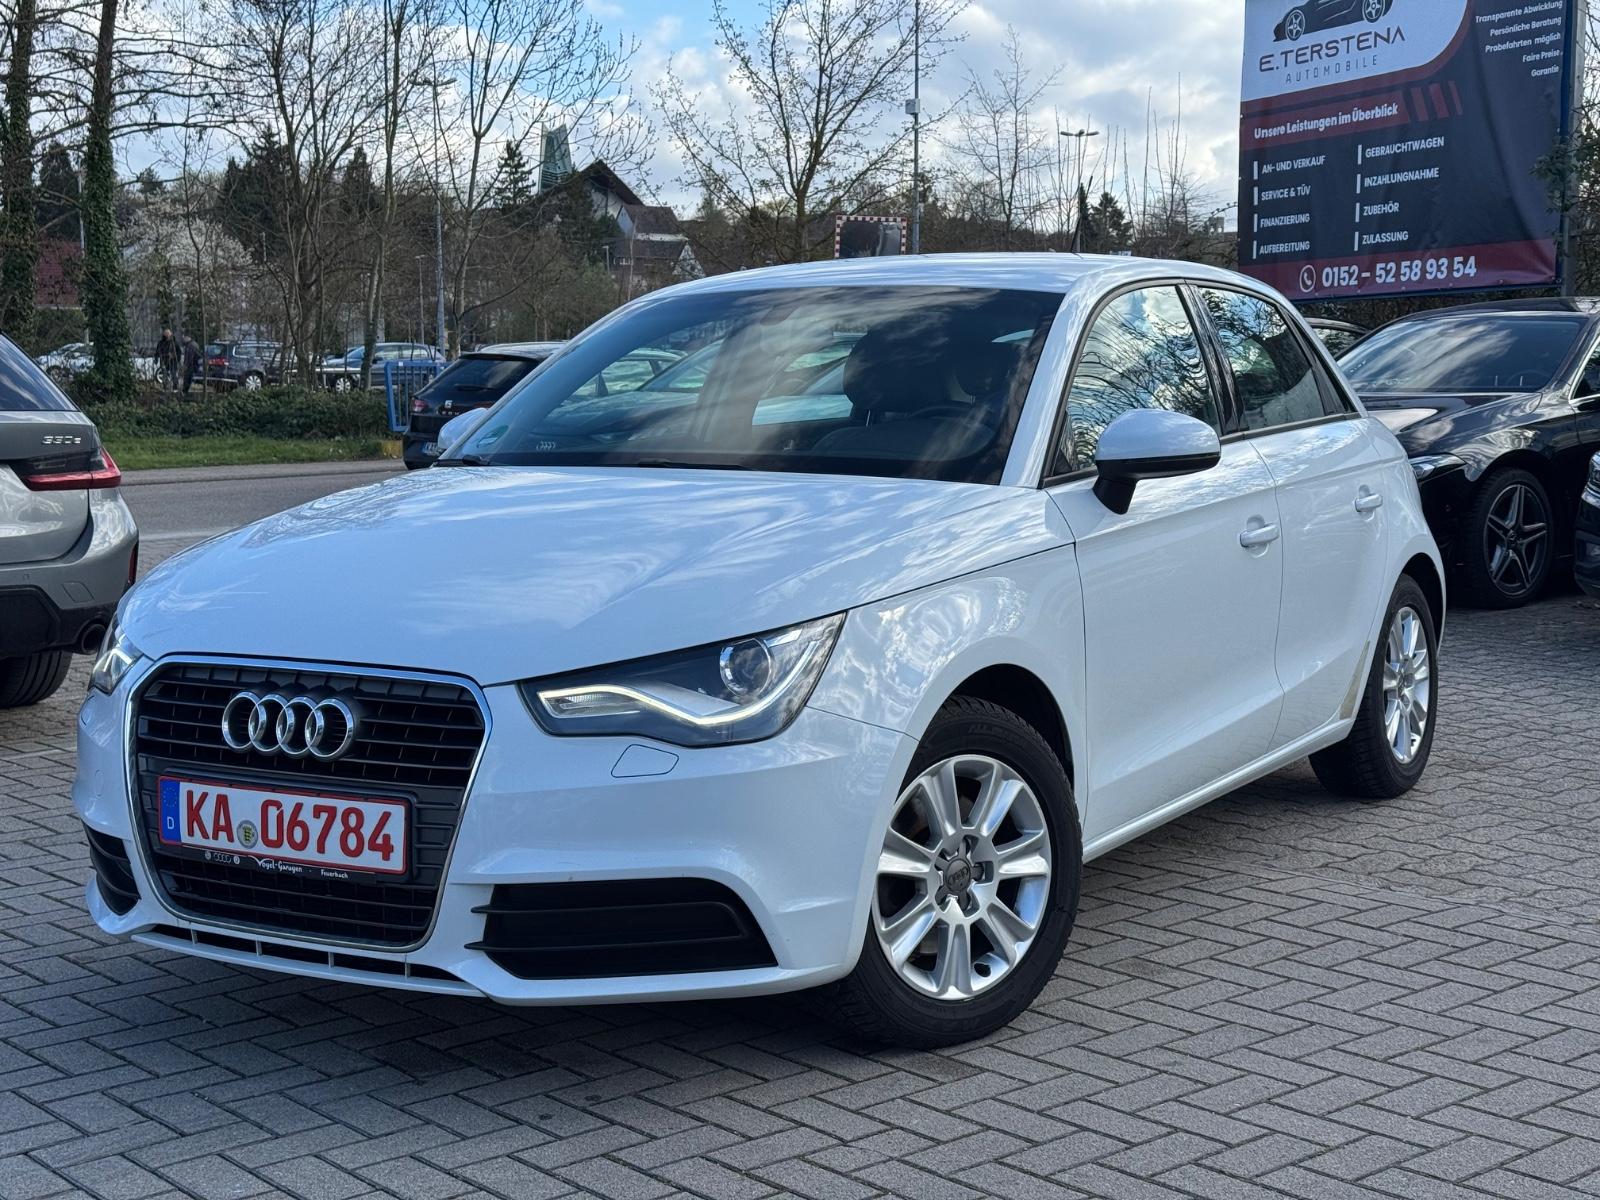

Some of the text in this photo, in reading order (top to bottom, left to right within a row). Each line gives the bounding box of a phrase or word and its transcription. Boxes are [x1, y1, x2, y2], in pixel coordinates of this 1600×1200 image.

[1475, 0, 1562, 23] Transparente Abwicklung
[1490, 17, 1562, 36] Persönliche Beratung
[1485, 32, 1561, 53] Probefahrten möglich
[1522, 49, 1560, 62] Faire Preise
[1286, 55, 1377, 83] AUTOMOBILE
[1531, 65, 1559, 77] Garantie
[1254, 102, 1399, 139] Unsere Leistungen im Überblick
[1365, 136, 1445, 158] GEBRAUCHTWAGEN
[1262, 155, 1326, 174] AN- UND VERKAUF
[1364, 168, 1440, 188] INZAHLUNGNAHME
[1261, 183, 1311, 201] SERVICE & TÜV
[1363, 201, 1399, 216] ZUBEHÖR
[1260, 213, 1310, 228] FINANZIERUNG
[1259, 240, 1310, 255] AUFBEREITUNG
[1362, 231, 1409, 245] ZULASSUNG
[1322, 265, 1359, 287] 0152
[1375, 262, 1397, 283] 52
[1400, 259, 1422, 281] 58
[1425, 257, 1448, 279] 93
[1453, 255, 1477, 277] 54
[166, 790, 394, 861] D KA 06784
[320, 869, 349, 879] Feuerbach
